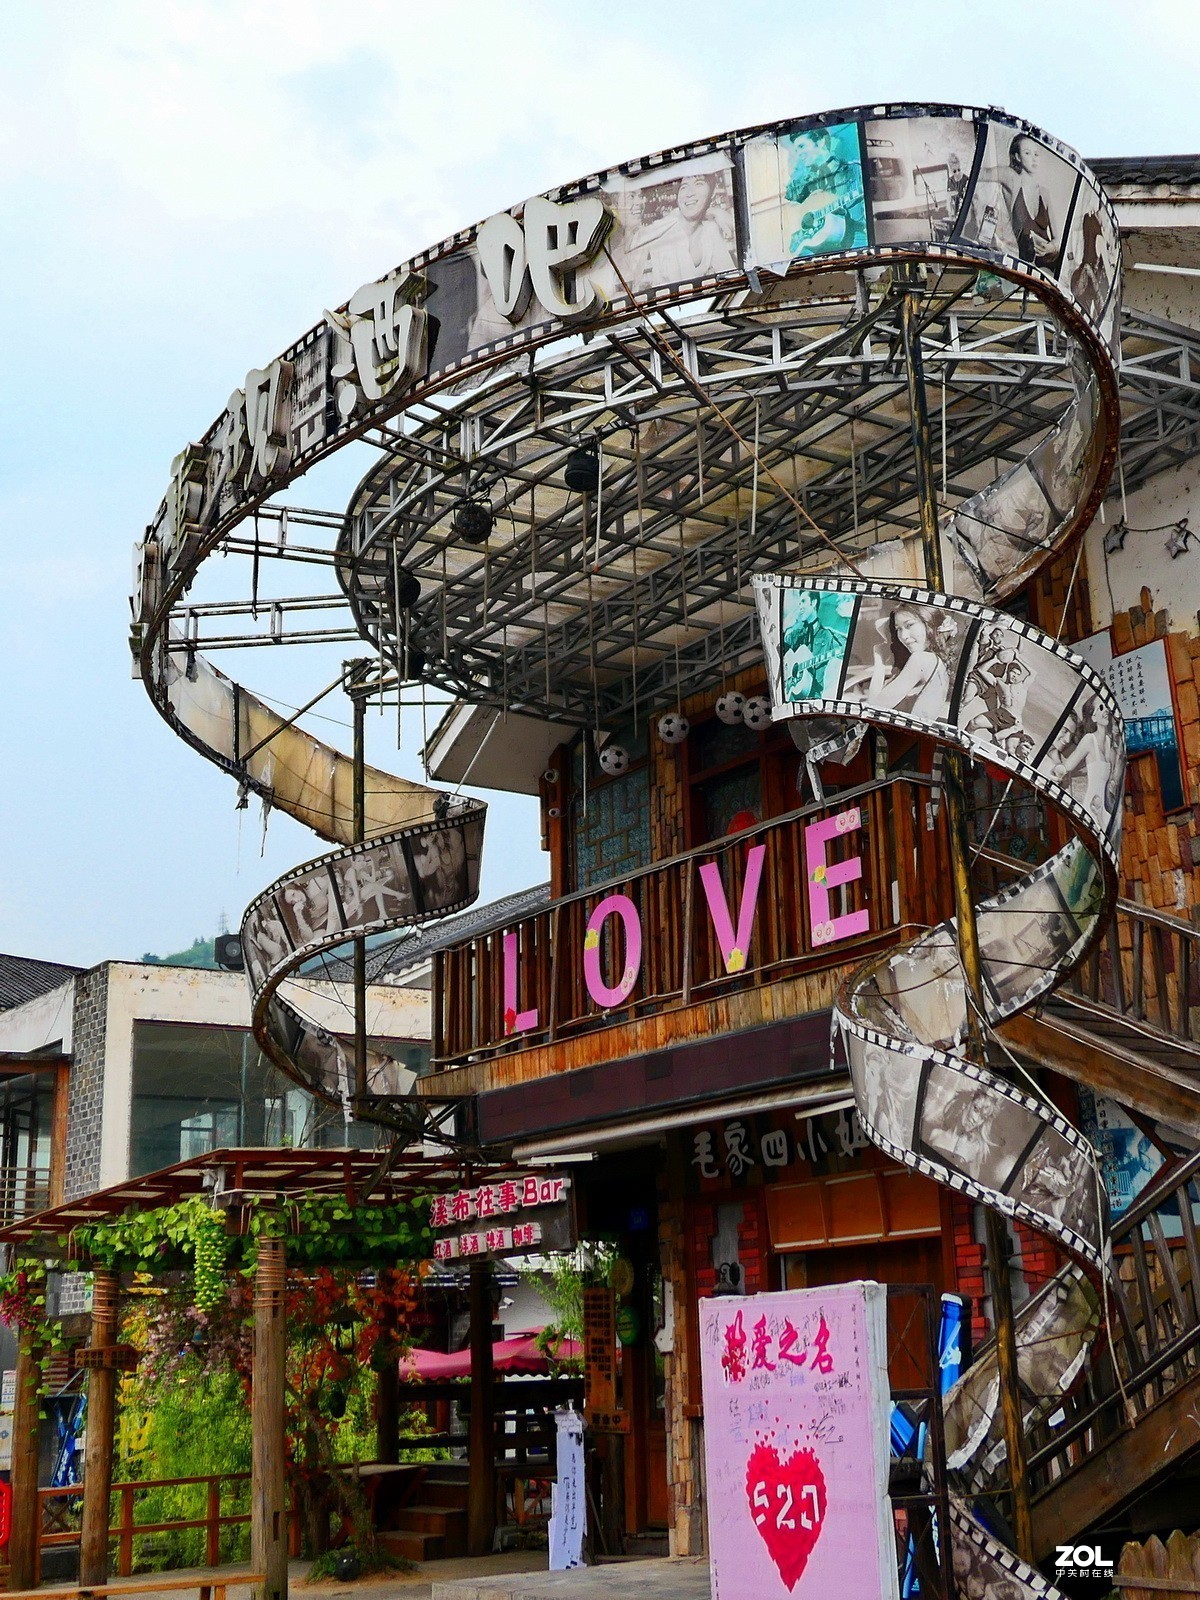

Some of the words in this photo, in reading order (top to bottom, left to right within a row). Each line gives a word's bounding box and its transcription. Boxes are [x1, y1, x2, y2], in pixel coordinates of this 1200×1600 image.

[503, 807, 870, 1036] LOVE
[690, 1109, 871, 1179] 毛家四小姐
[753, 1481, 821, 1531] 520
